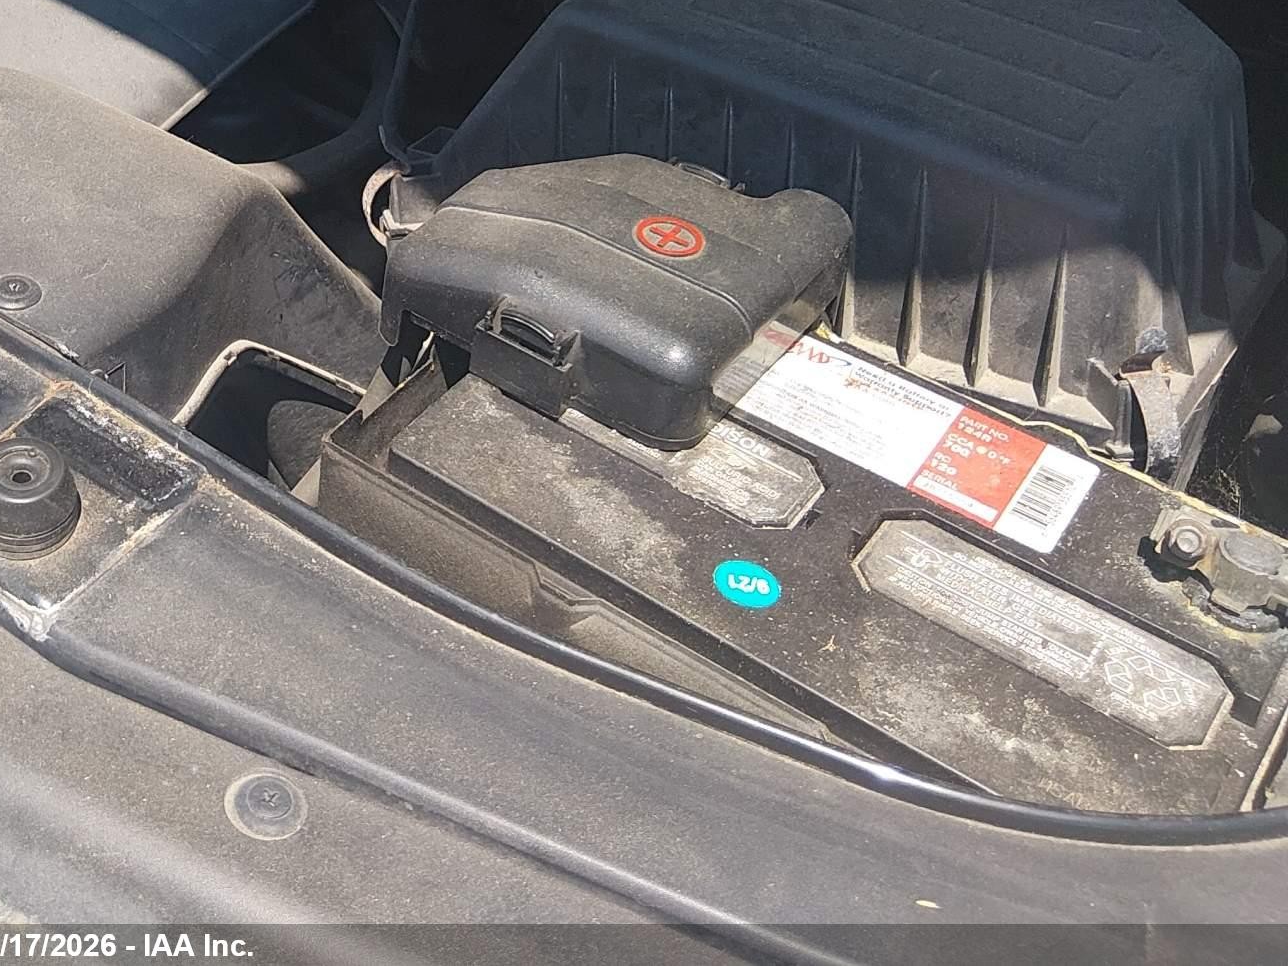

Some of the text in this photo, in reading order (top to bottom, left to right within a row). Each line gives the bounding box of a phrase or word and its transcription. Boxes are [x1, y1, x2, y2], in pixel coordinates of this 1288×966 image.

[959, 415, 1010, 442] PART NO.
[947, 433, 974, 450] CCA
[930, 458, 958, 476] 120
[920, 468, 960, 490] SERIAL
[938, 566, 967, 584] WITH
[934, 572, 1042, 631] MEDICAL HELP FAST
[943, 559, 1082, 634] FLUSH EYES IMMEDIATELY
